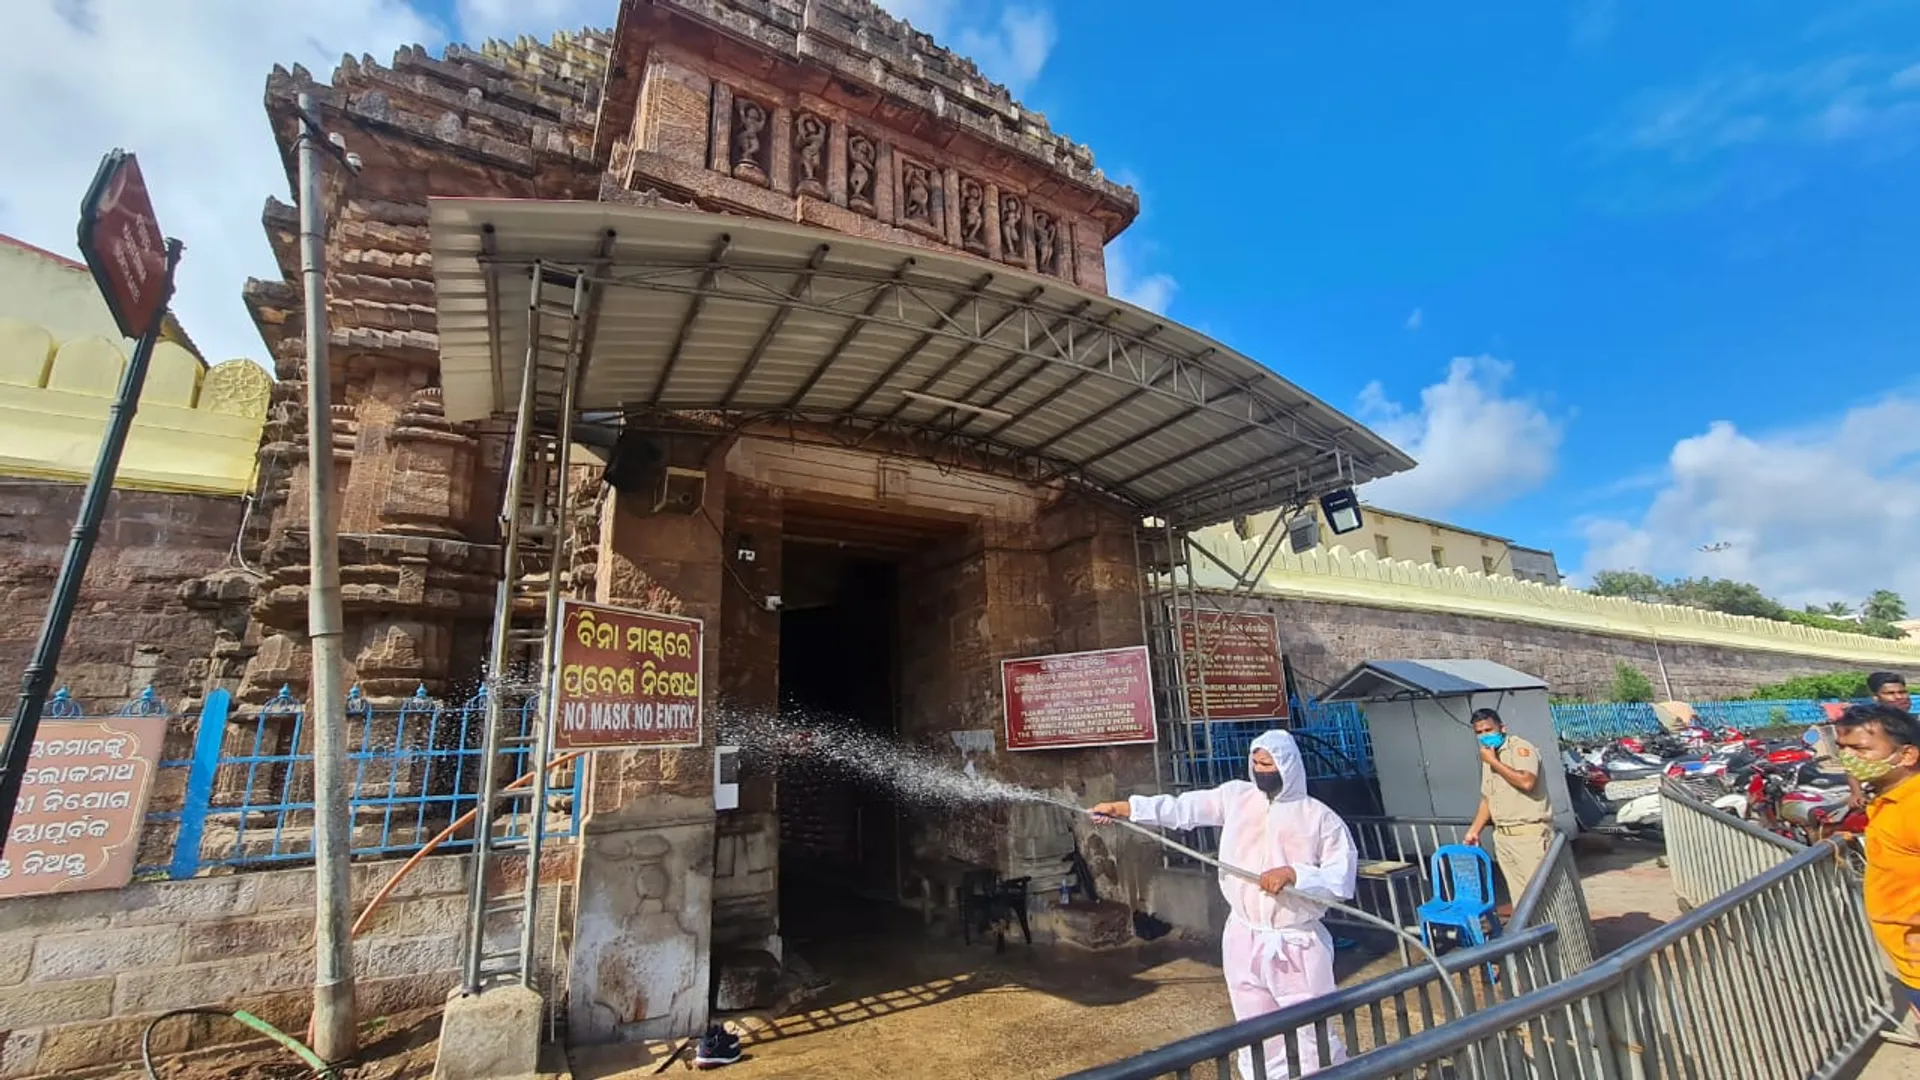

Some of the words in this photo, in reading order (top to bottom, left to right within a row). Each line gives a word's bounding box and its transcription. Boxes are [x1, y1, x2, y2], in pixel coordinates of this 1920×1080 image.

[577, 611, 618, 650] ବିନା
[626, 626, 691, 662] ମାସ୍କରେ
[563, 664, 635, 697] ପ୍ରବେଶ
[642, 660, 697, 696] ନିଷେଧ
[563, 702, 586, 730] NO
[590, 702, 632, 730] MASK
[634, 703, 653, 730] NO
[656, 703, 695, 729] ENTRY
